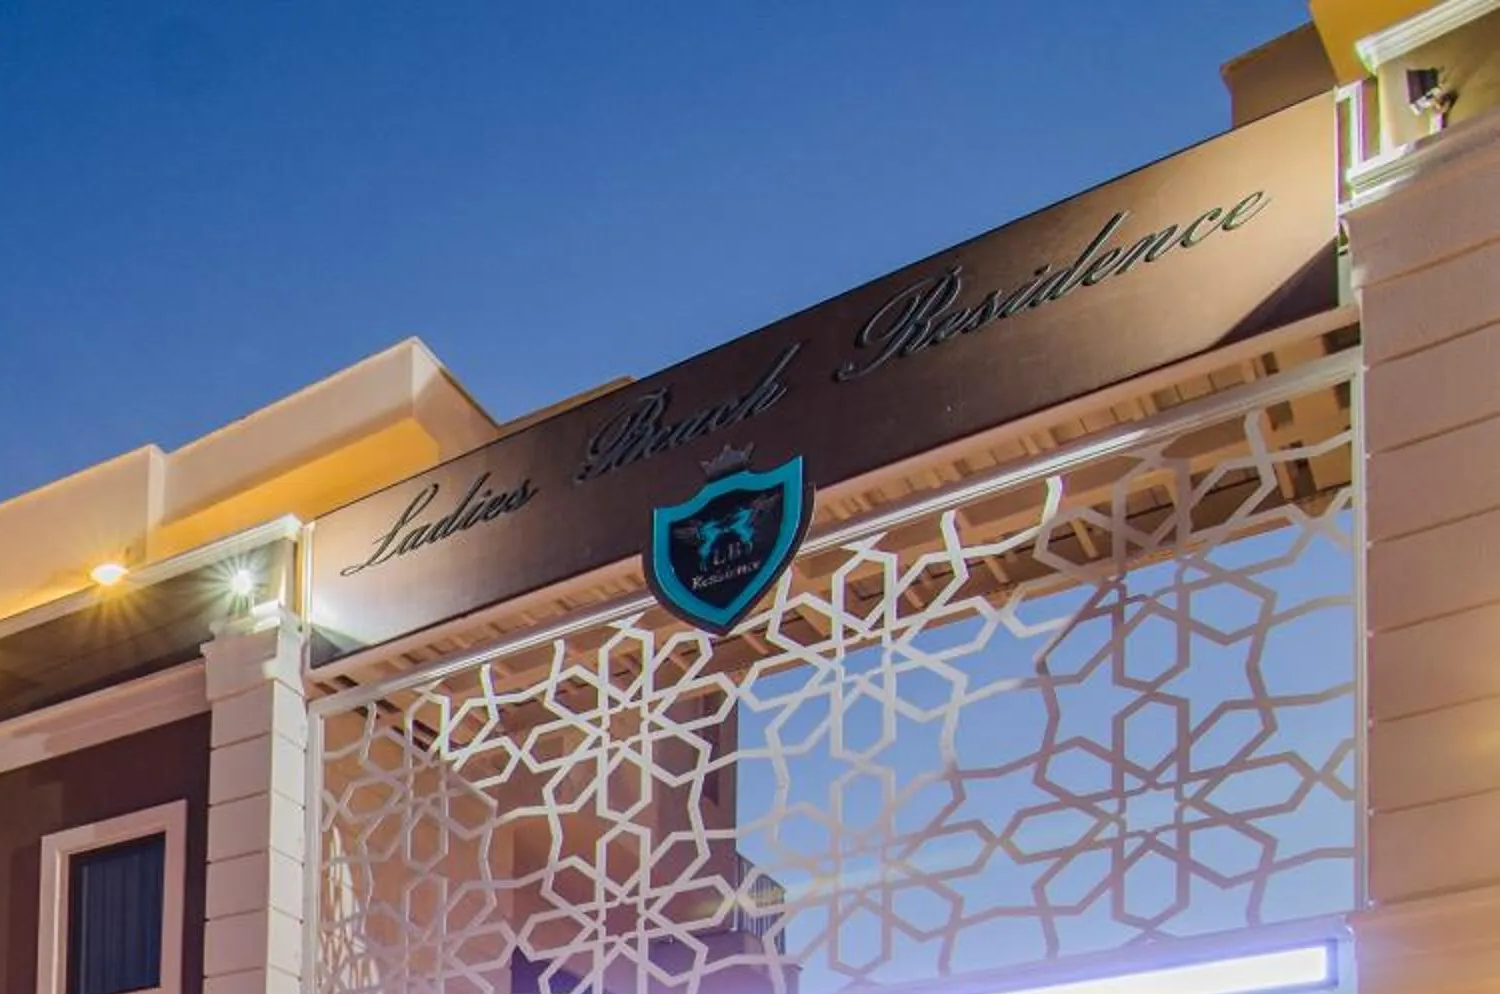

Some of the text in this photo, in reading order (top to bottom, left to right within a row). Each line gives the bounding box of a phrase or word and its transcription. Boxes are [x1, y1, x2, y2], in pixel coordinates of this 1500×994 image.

[340, 190, 1271, 576] Ladies Beach Residence
